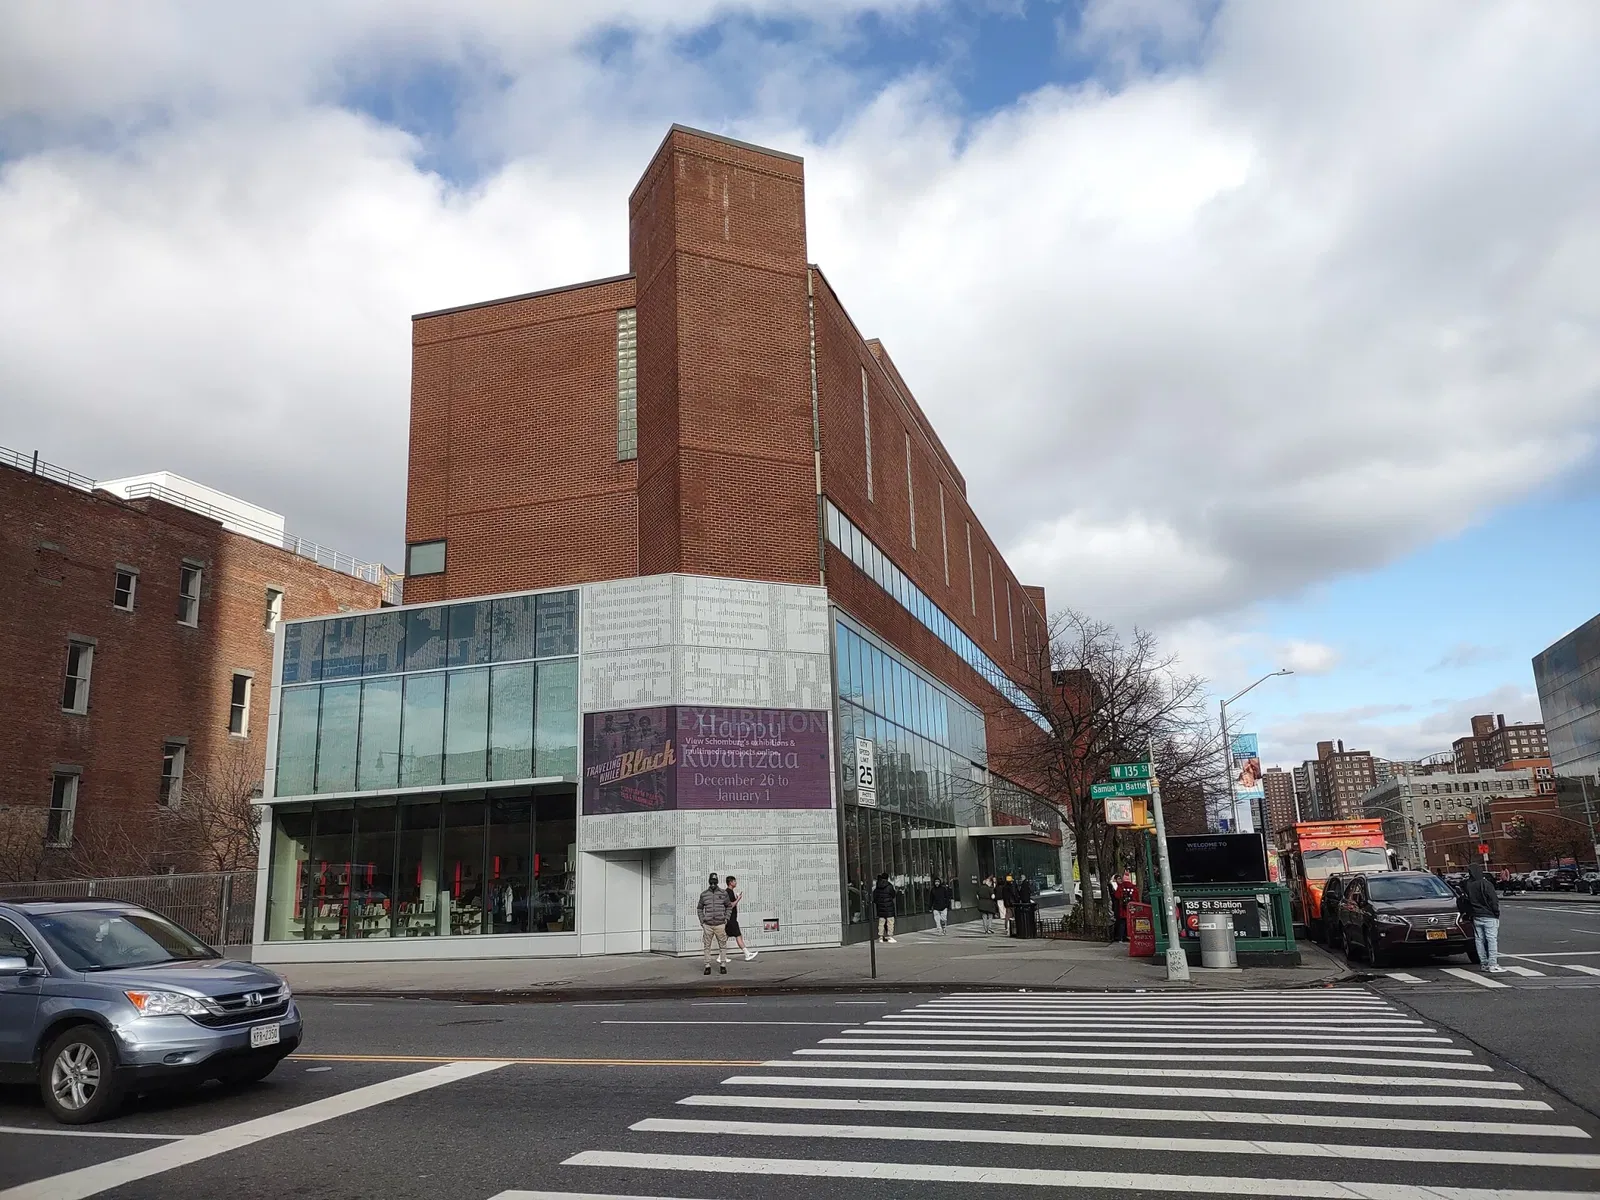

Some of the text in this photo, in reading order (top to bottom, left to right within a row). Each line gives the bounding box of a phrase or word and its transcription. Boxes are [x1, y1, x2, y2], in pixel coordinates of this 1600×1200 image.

[678, 708, 827, 733] EXHIBITION
[697, 714, 781, 742] Happy
[685, 737, 703, 745] View
[705, 737, 749, 747] Schomburg's
[751, 738, 788, 747] exhibitions
[586, 739, 676, 777] TRAVELING Black
[681, 744, 799, 769] Kwanzaa
[859, 748, 870, 756] SPEED
[600, 768, 620, 783] WHILE
[859, 765, 873, 785] 25
[1113, 767, 1121, 777] W
[1124, 766, 1139, 777] 135
[694, 772, 789, 786] December 26 to
[1093, 782, 1146, 793] Samuel J Battle
[717, 788, 770, 804] January 1
[1185, 900, 1242, 909] 135 St Station
[1191, 918, 1199, 927] 2
